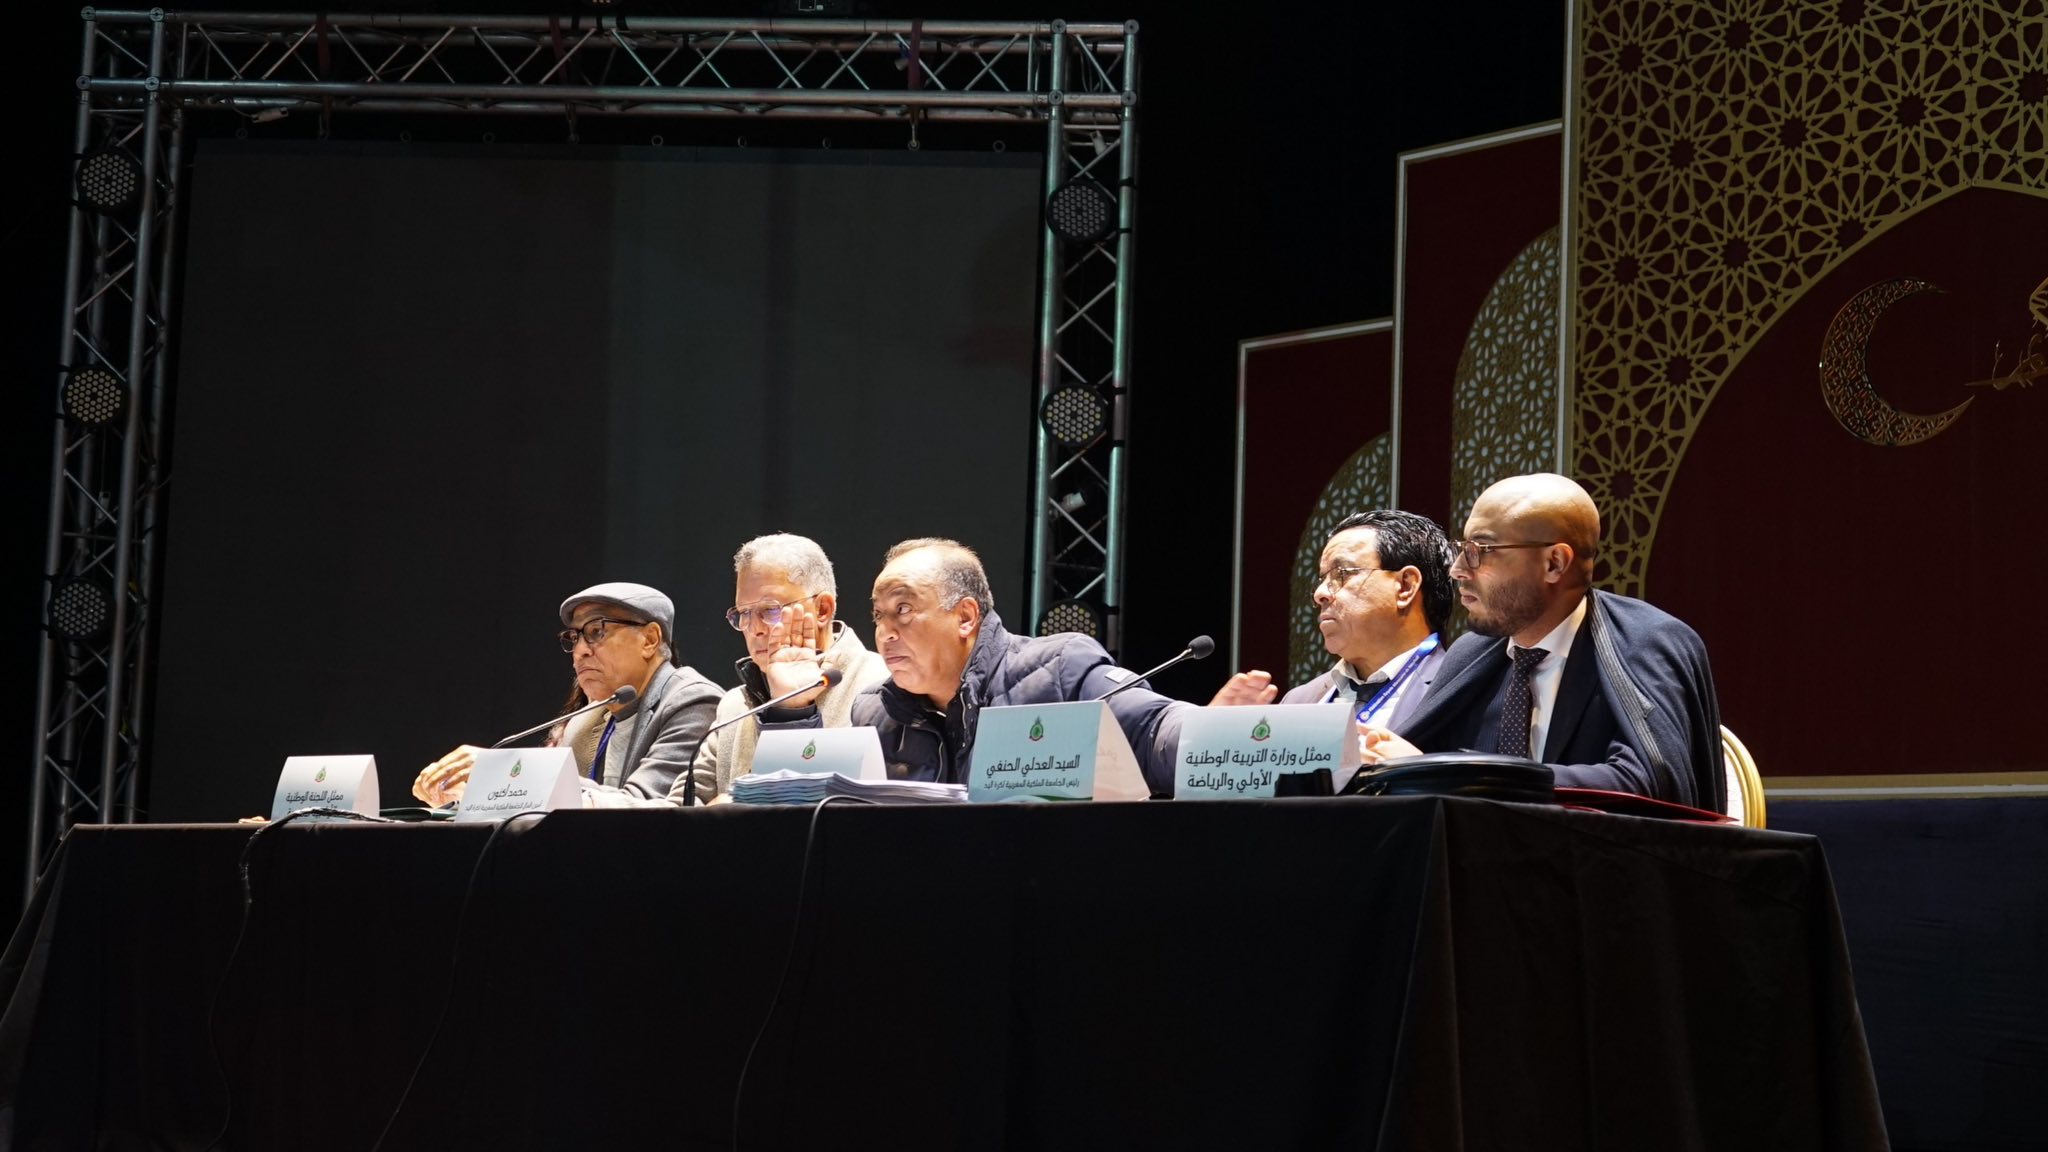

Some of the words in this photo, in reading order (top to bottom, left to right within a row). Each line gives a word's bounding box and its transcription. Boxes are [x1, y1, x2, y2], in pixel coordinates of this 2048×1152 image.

[1054, 754, 1081, 772] السيد
[1186, 749, 1230, 767] الوطنية
[1232, 748, 1268, 767] التربية
[1270, 748, 1297, 766] وزارة
[1299, 746, 1331, 766] ممثل
[986, 757, 1021, 779] الحنفي
[1021, 755, 1054, 778] العدلي
[1187, 772, 1234, 791] والرياضة
[1236, 769, 1272, 793] الأولي
[285, 790, 310, 804] الوطنية
[309, 790, 328, 802] اللجنة
[327, 790, 344, 804] ممثل
[507, 788, 528, 798] محمد
